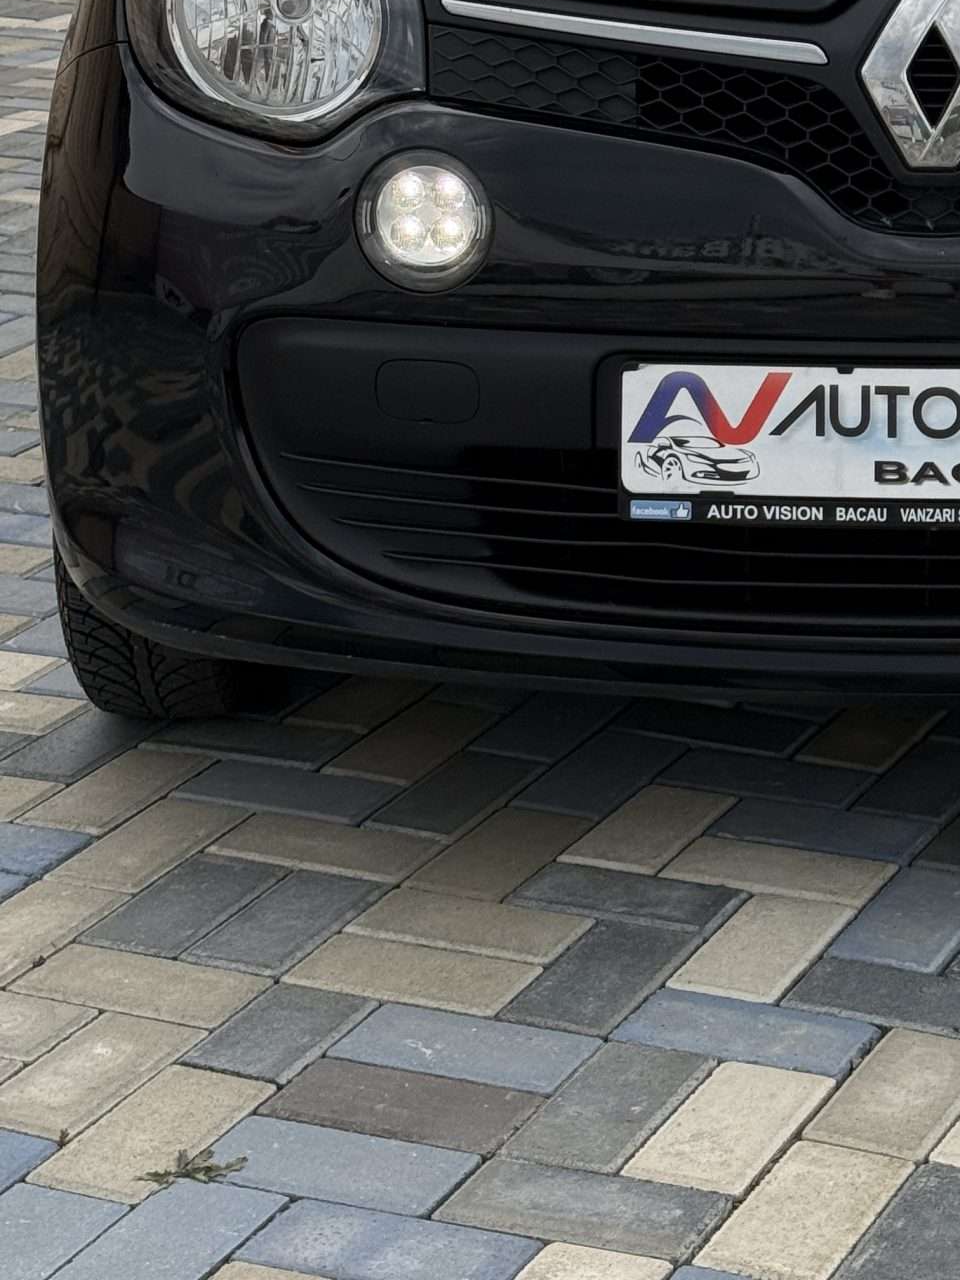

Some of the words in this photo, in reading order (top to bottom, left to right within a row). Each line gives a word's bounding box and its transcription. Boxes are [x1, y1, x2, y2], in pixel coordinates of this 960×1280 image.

[707, 505, 758, 519] AUTO
[763, 505, 823, 521] VISION
[836, 507, 887, 522] BACAU
[900, 508, 955, 523] VANZARI
